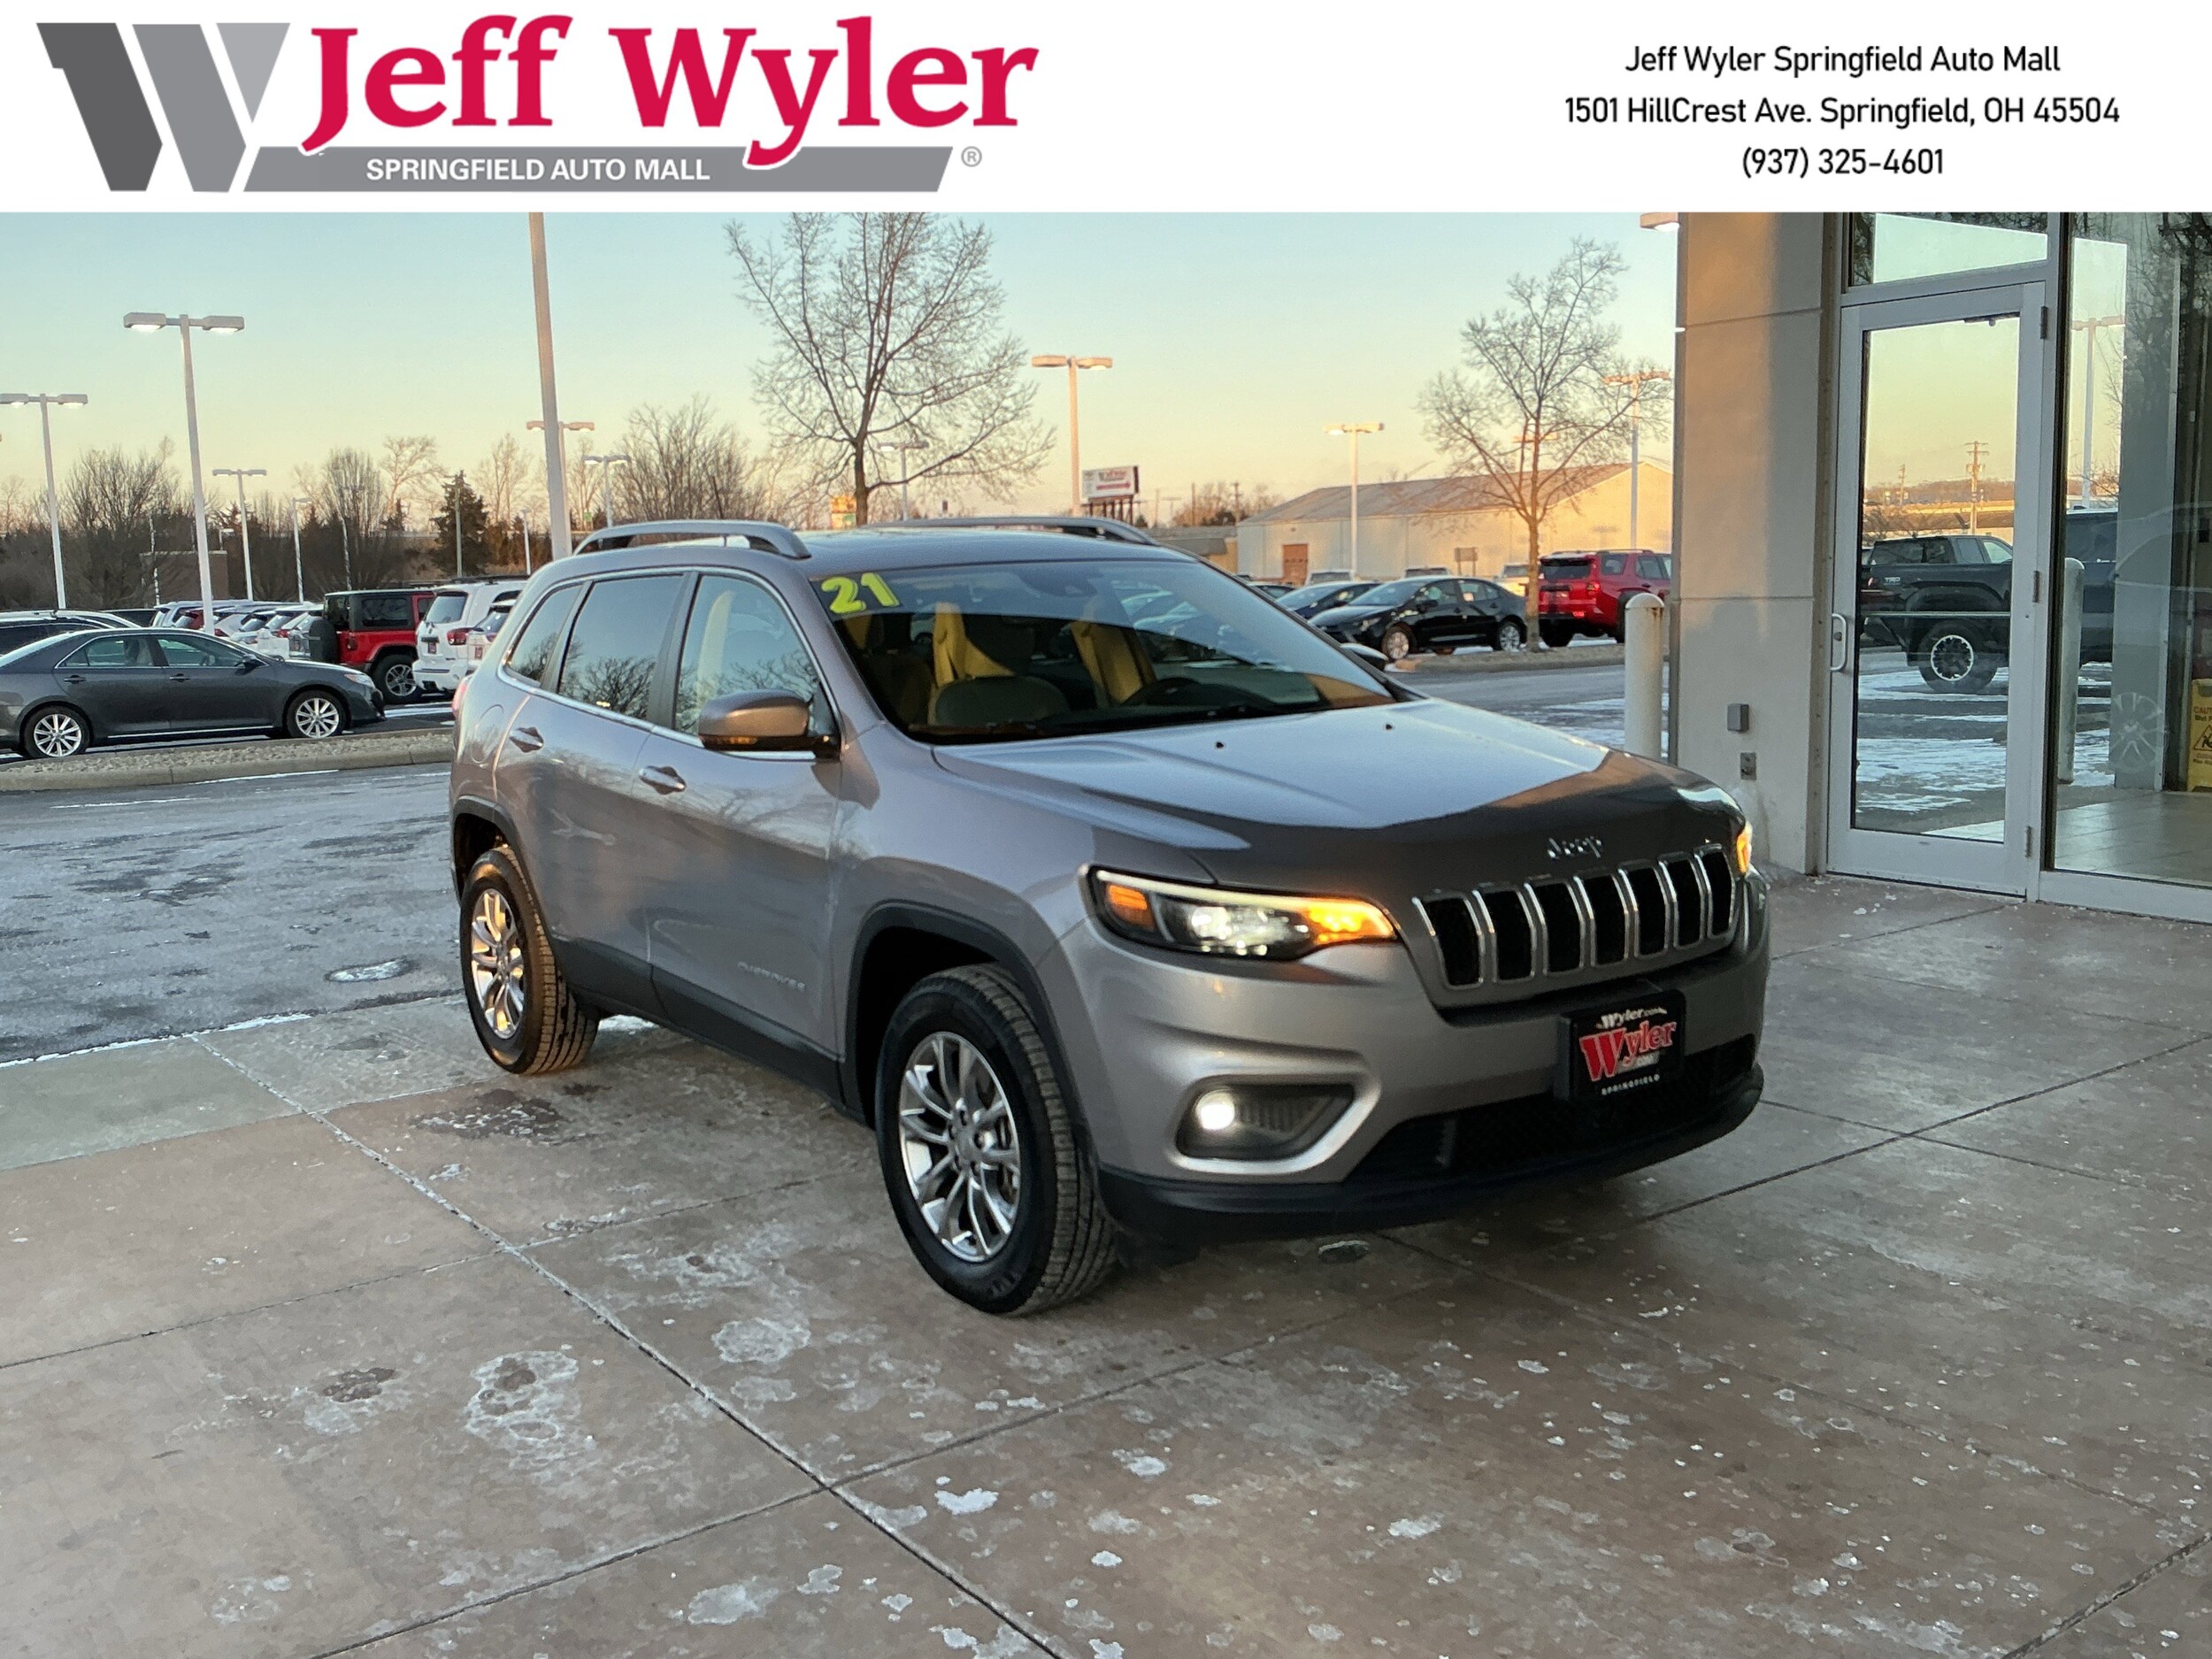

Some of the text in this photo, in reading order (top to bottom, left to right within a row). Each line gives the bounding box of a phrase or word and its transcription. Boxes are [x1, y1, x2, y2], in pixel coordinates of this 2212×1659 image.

[821, 572, 900, 613] 21
[1548, 836, 1601, 859] Jeep
[1578, 1020, 1677, 1082] Wyler
